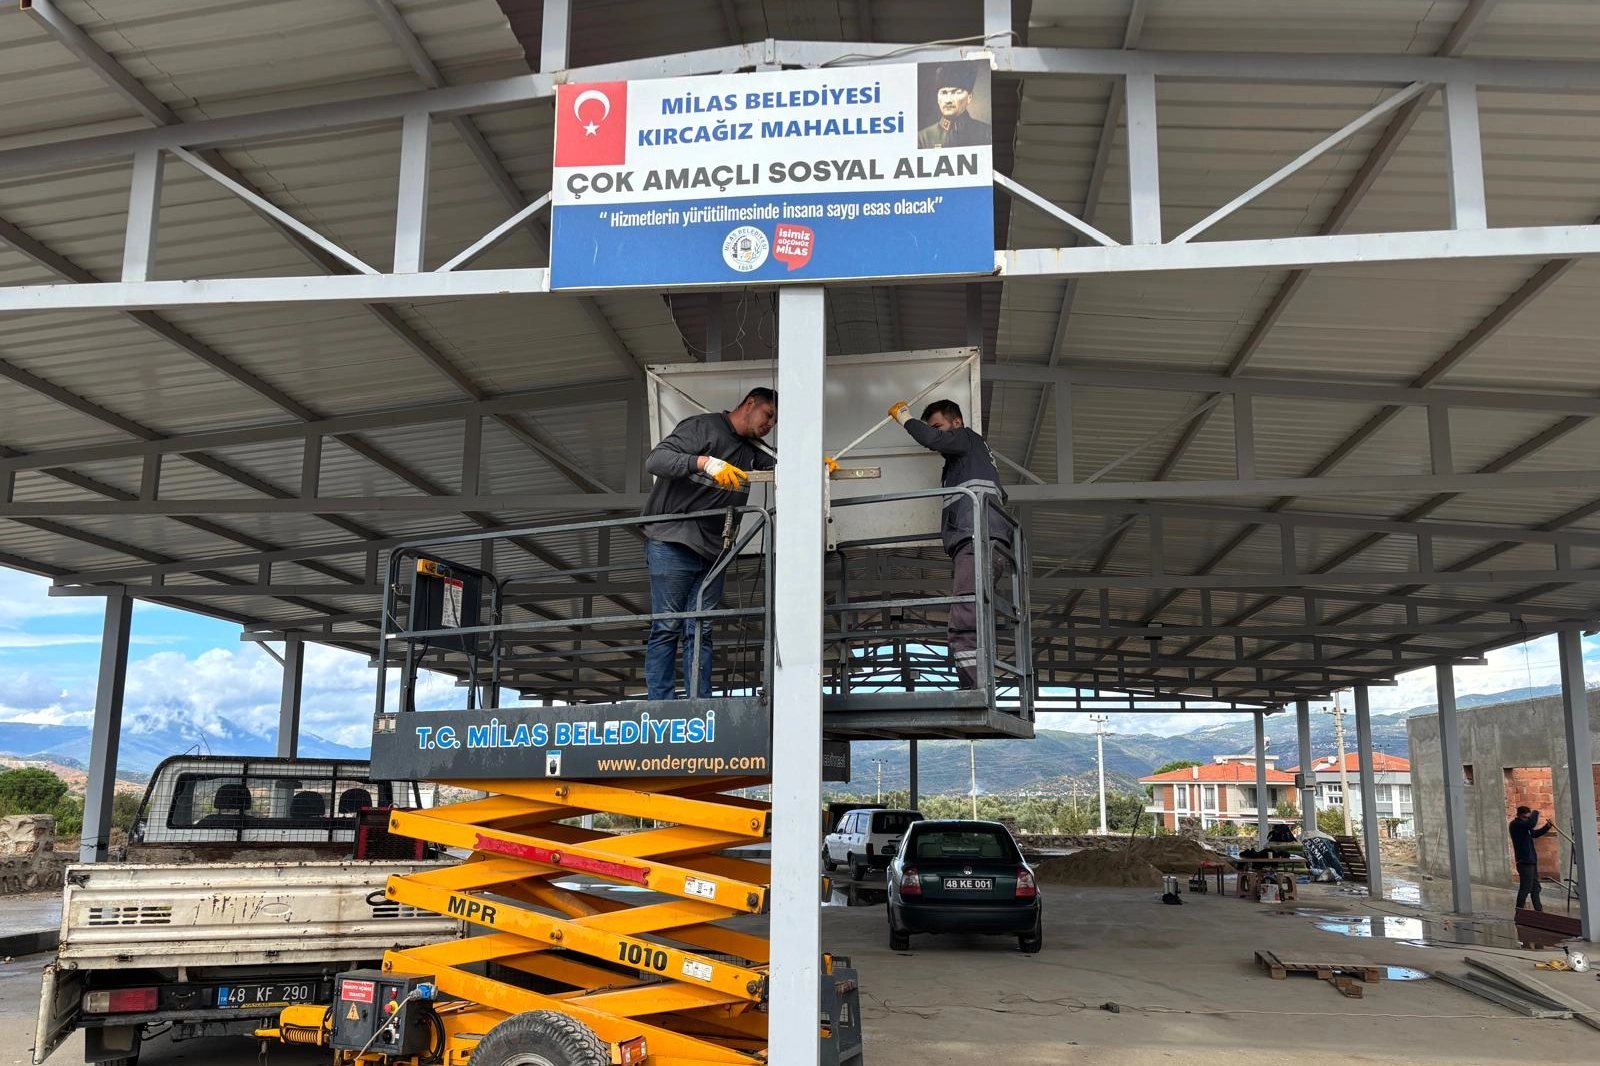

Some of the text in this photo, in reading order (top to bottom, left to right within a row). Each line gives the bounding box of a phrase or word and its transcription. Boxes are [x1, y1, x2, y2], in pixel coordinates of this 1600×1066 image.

[662, 81, 881, 115] MİLAS BELEDİYESİ
[638, 111, 904, 146] KIRCAĞIZ MAHALLESİ
[567, 153, 978, 199] ÇOK AMAÇLI SOSYAL ALAN
[682, 203, 780, 226] yürütülmesinde
[783, 202, 823, 219] insana
[826, 203, 860, 220] saygı
[863, 201, 891, 216] esas
[416, 710, 715, 749] T.C. MİLAS BELEDİYESİ
[597, 754, 766, 774] www.ondergrup.com
[946, 880, 991, 888] 48 KE 001
[447, 895, 497, 925] MPR
[618, 941, 668, 972] 1010
[228, 988, 246, 1003] 48
[256, 986, 274, 1002] KF
[282, 985, 308, 1001] 290
